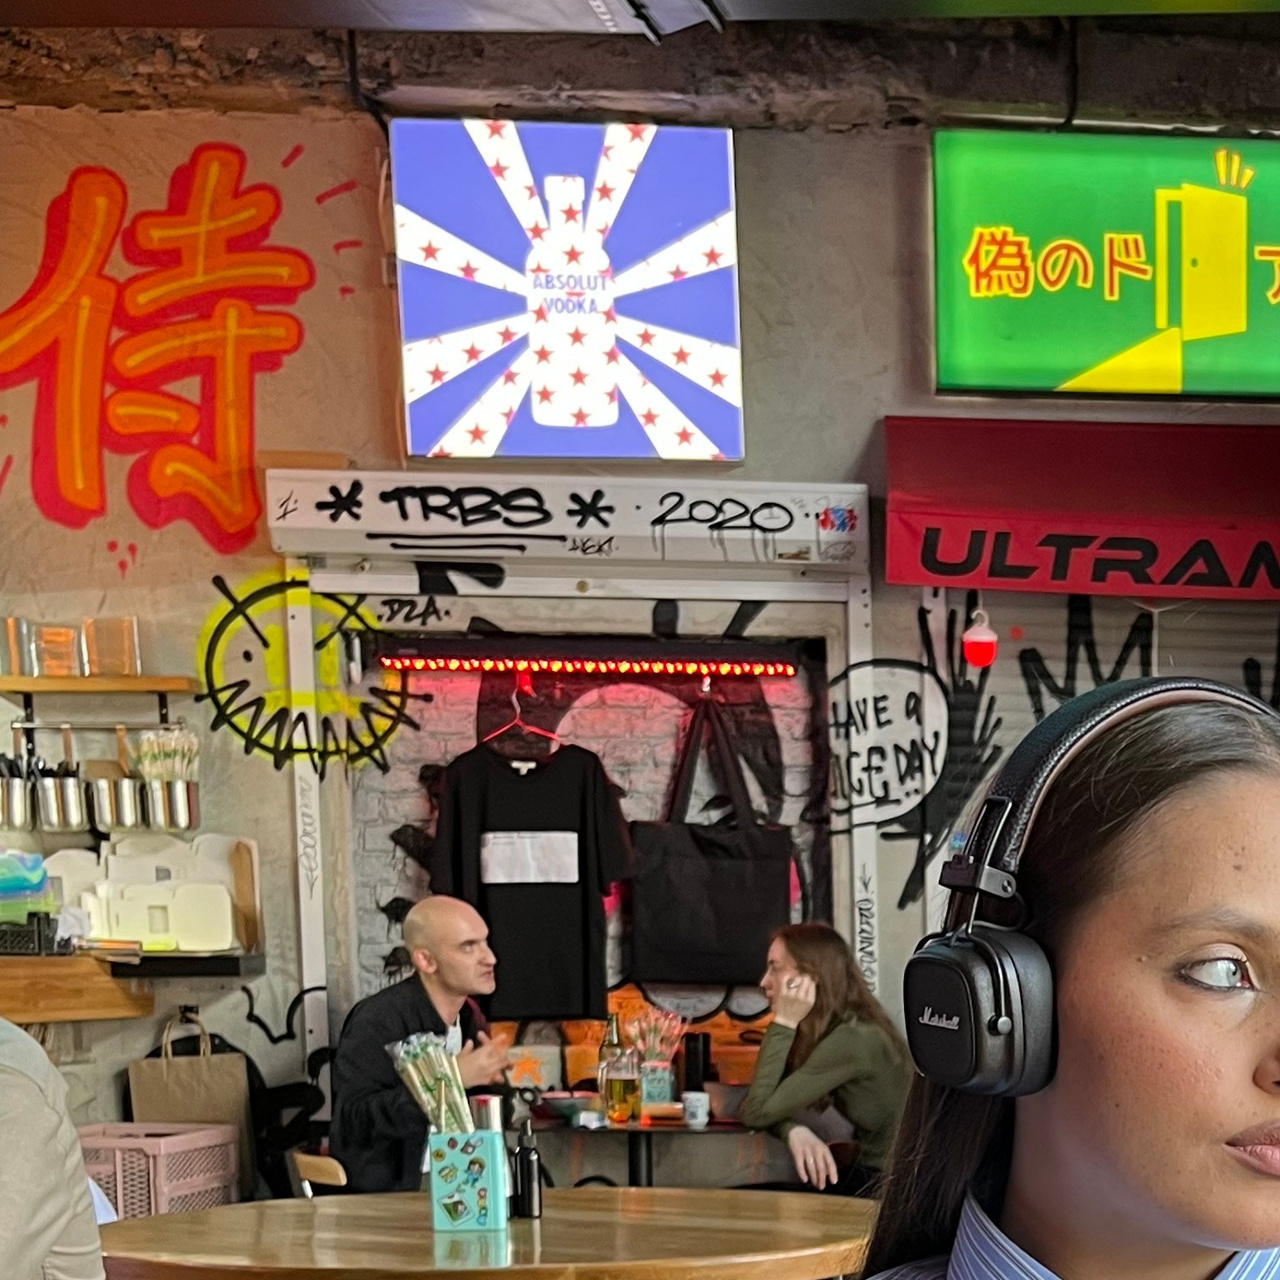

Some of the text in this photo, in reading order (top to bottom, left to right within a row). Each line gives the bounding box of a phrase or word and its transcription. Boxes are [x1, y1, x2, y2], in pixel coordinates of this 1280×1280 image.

[533, 274, 606, 291] ABSOLUT
[962, 226, 1153, 301] 偽のド
[543, 297, 598, 314] VODKA
[0, 142, 315, 553] 侍
[650, 491, 794, 533] 2020
[830, 695, 893, 740] HAVE
[893, 730, 939, 785] DAY
